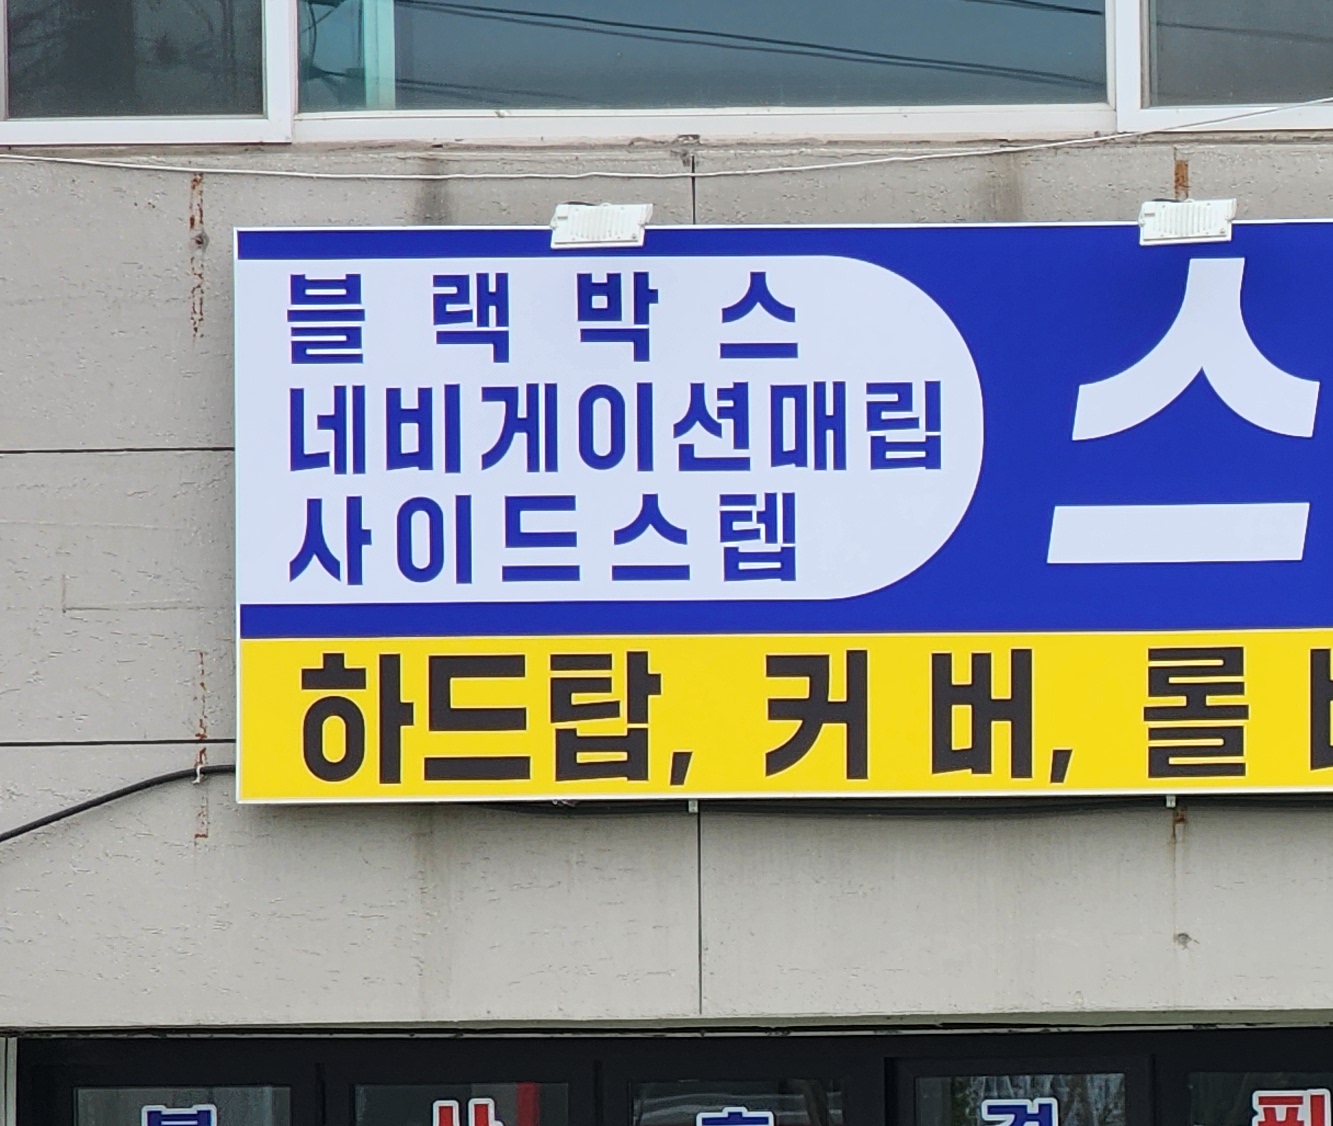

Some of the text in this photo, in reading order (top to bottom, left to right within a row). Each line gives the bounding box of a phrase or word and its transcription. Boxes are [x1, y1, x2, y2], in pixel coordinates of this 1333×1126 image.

[288, 379, 944, 474] 네비게이션매립
[288, 492, 798, 585] 사이드스텝
[300, 649, 695, 787] 하드탑,
